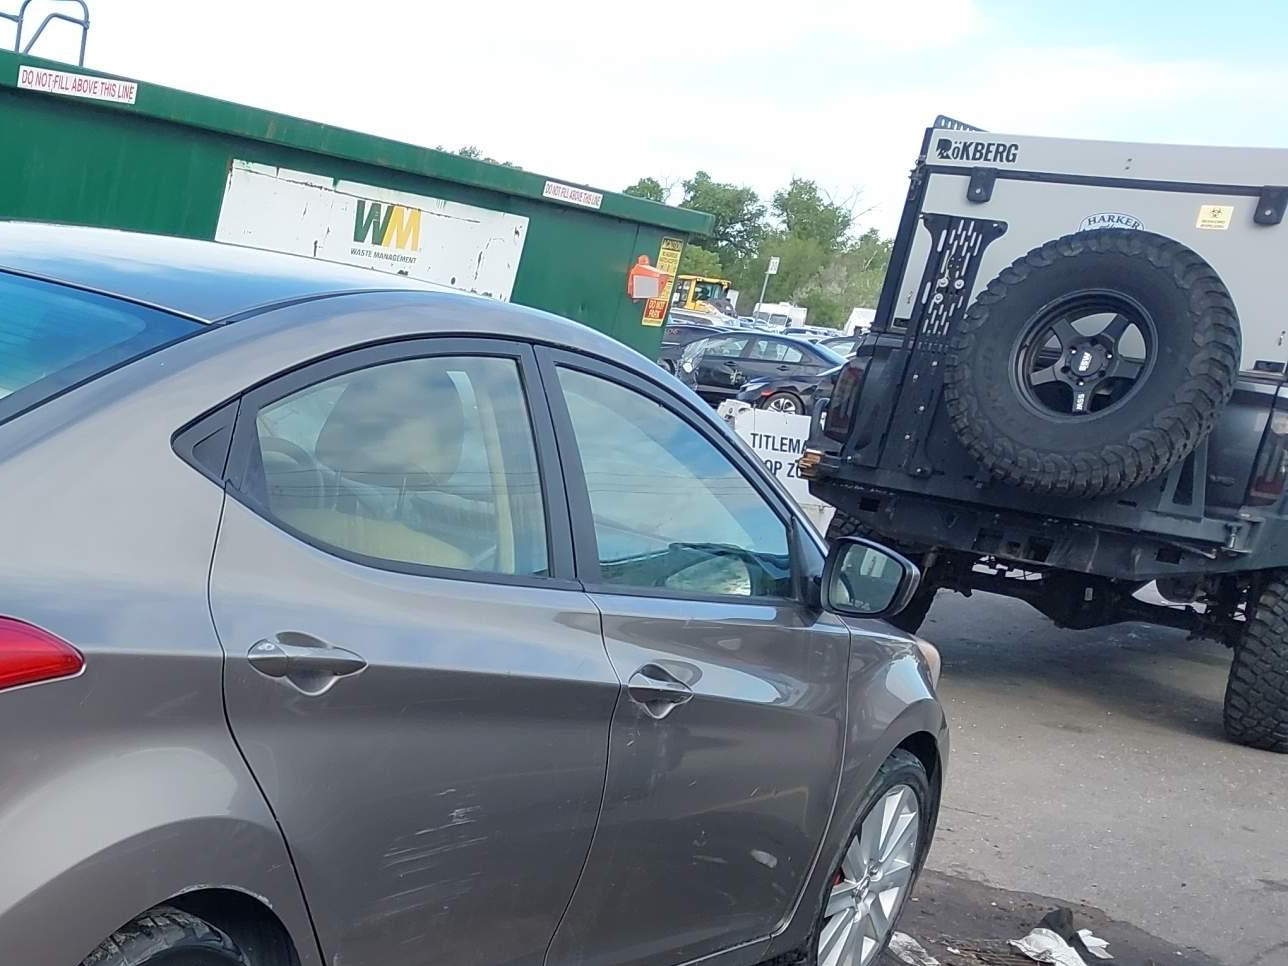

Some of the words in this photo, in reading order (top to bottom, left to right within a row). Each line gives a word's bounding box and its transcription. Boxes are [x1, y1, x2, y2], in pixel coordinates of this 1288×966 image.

[21, 70, 34, 85] DO
[35, 72, 53, 88] NOT
[53, 75, 70, 91] FILL
[72, 77, 98, 95] ABOVE
[100, 82, 116, 98] THIS
[117, 84, 135, 100] LINE
[353, 200, 422, 252] WM
[1087, 214, 1141, 230] HARKER
[350, 247, 373, 258] WASTE
[373, 251, 417, 264] MANAGEMENT
[763, 459, 783, 476] OP
